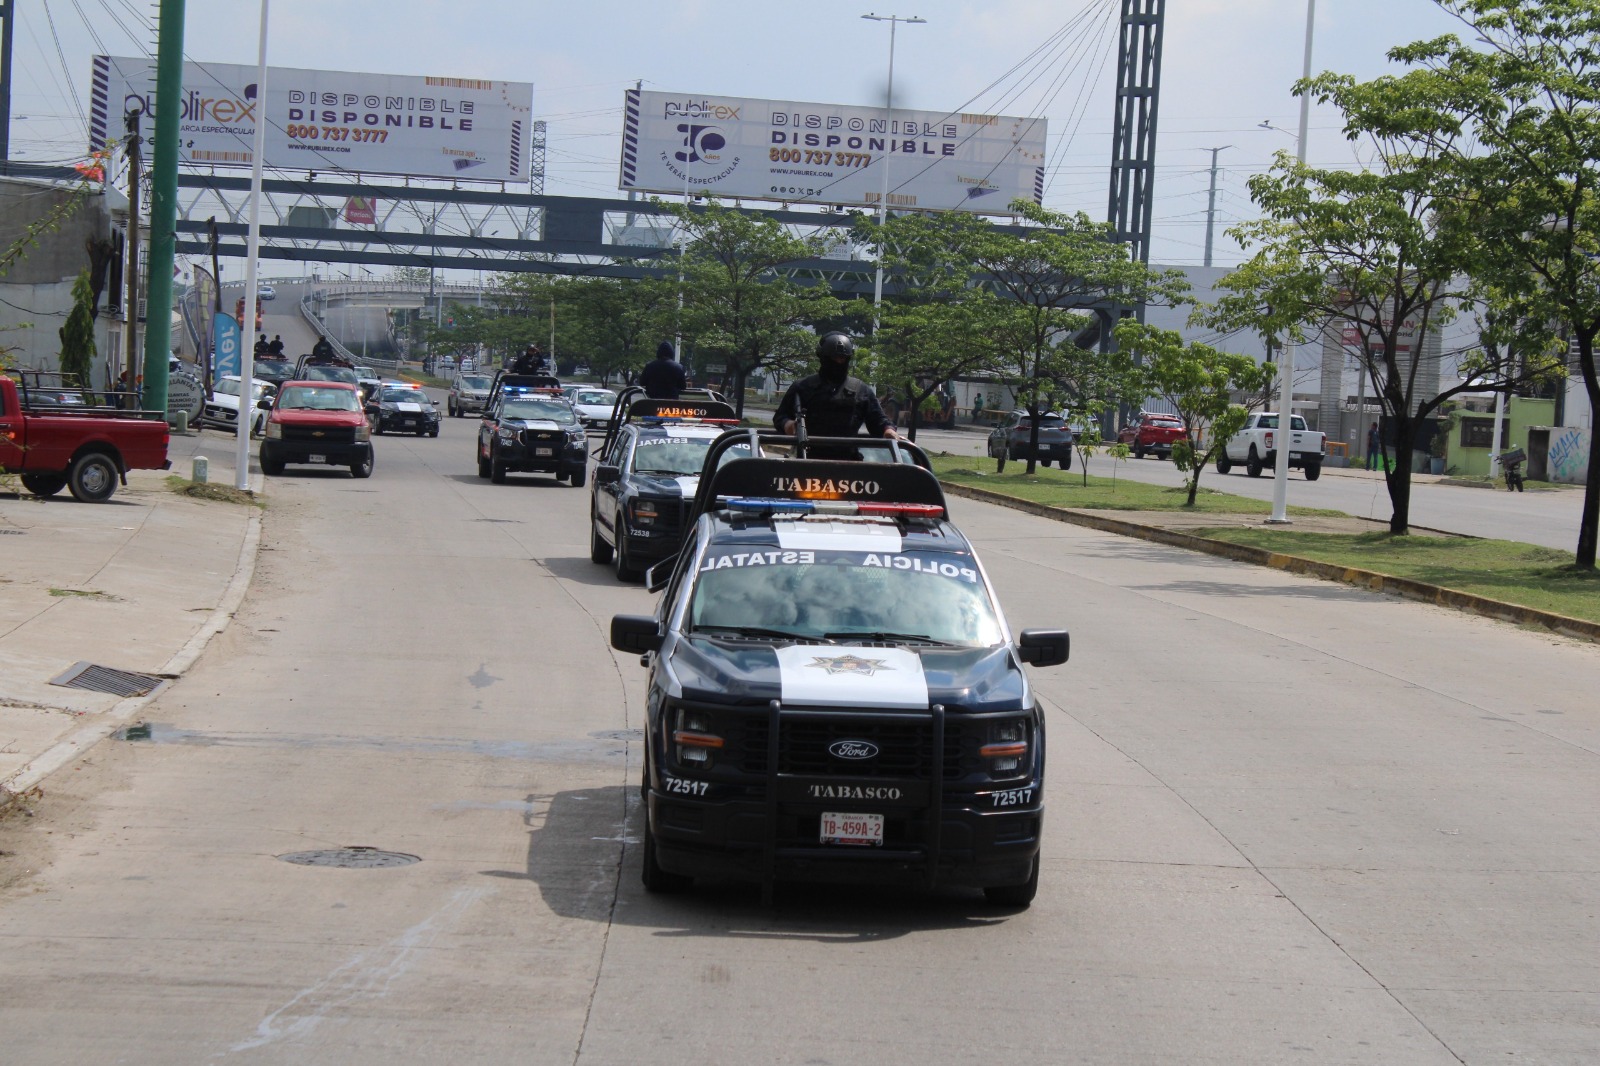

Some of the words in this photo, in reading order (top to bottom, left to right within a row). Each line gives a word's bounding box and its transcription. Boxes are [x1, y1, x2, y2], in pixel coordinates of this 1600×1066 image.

[124, 91, 256, 123] pulirex
[288, 90, 474, 114] DISPONIBLE
[664, 99, 741, 120] publirex
[180, 125, 200, 133] ARCA
[288, 108, 473, 131] DISPONIBLE
[772, 112, 957, 138] DISPONIBLE
[287, 124, 318, 139] 800
[321, 126, 349, 141] 737
[351, 127, 388, 144] 3777
[771, 131, 956, 156] DISPONIBLE
[660, 150, 668, 161] TE
[665, 161, 687, 181] VERÁS
[688, 156, 741, 184] ESPECTACULAR
[769, 147, 801, 163] 800
[804, 149, 832, 165] 737
[834, 151, 872, 168] 3777
[657, 407, 707, 416] TABASCO
[773, 477, 880, 495] TABASCO
[630, 529, 650, 538] 72538
[838, 742, 869, 756] Ford
[666, 777, 709, 796] 72517
[810, 784, 901, 800] TABASCO
[991, 789, 1032, 807] 72517
[823, 820, 881, 837] TB-459A-2
